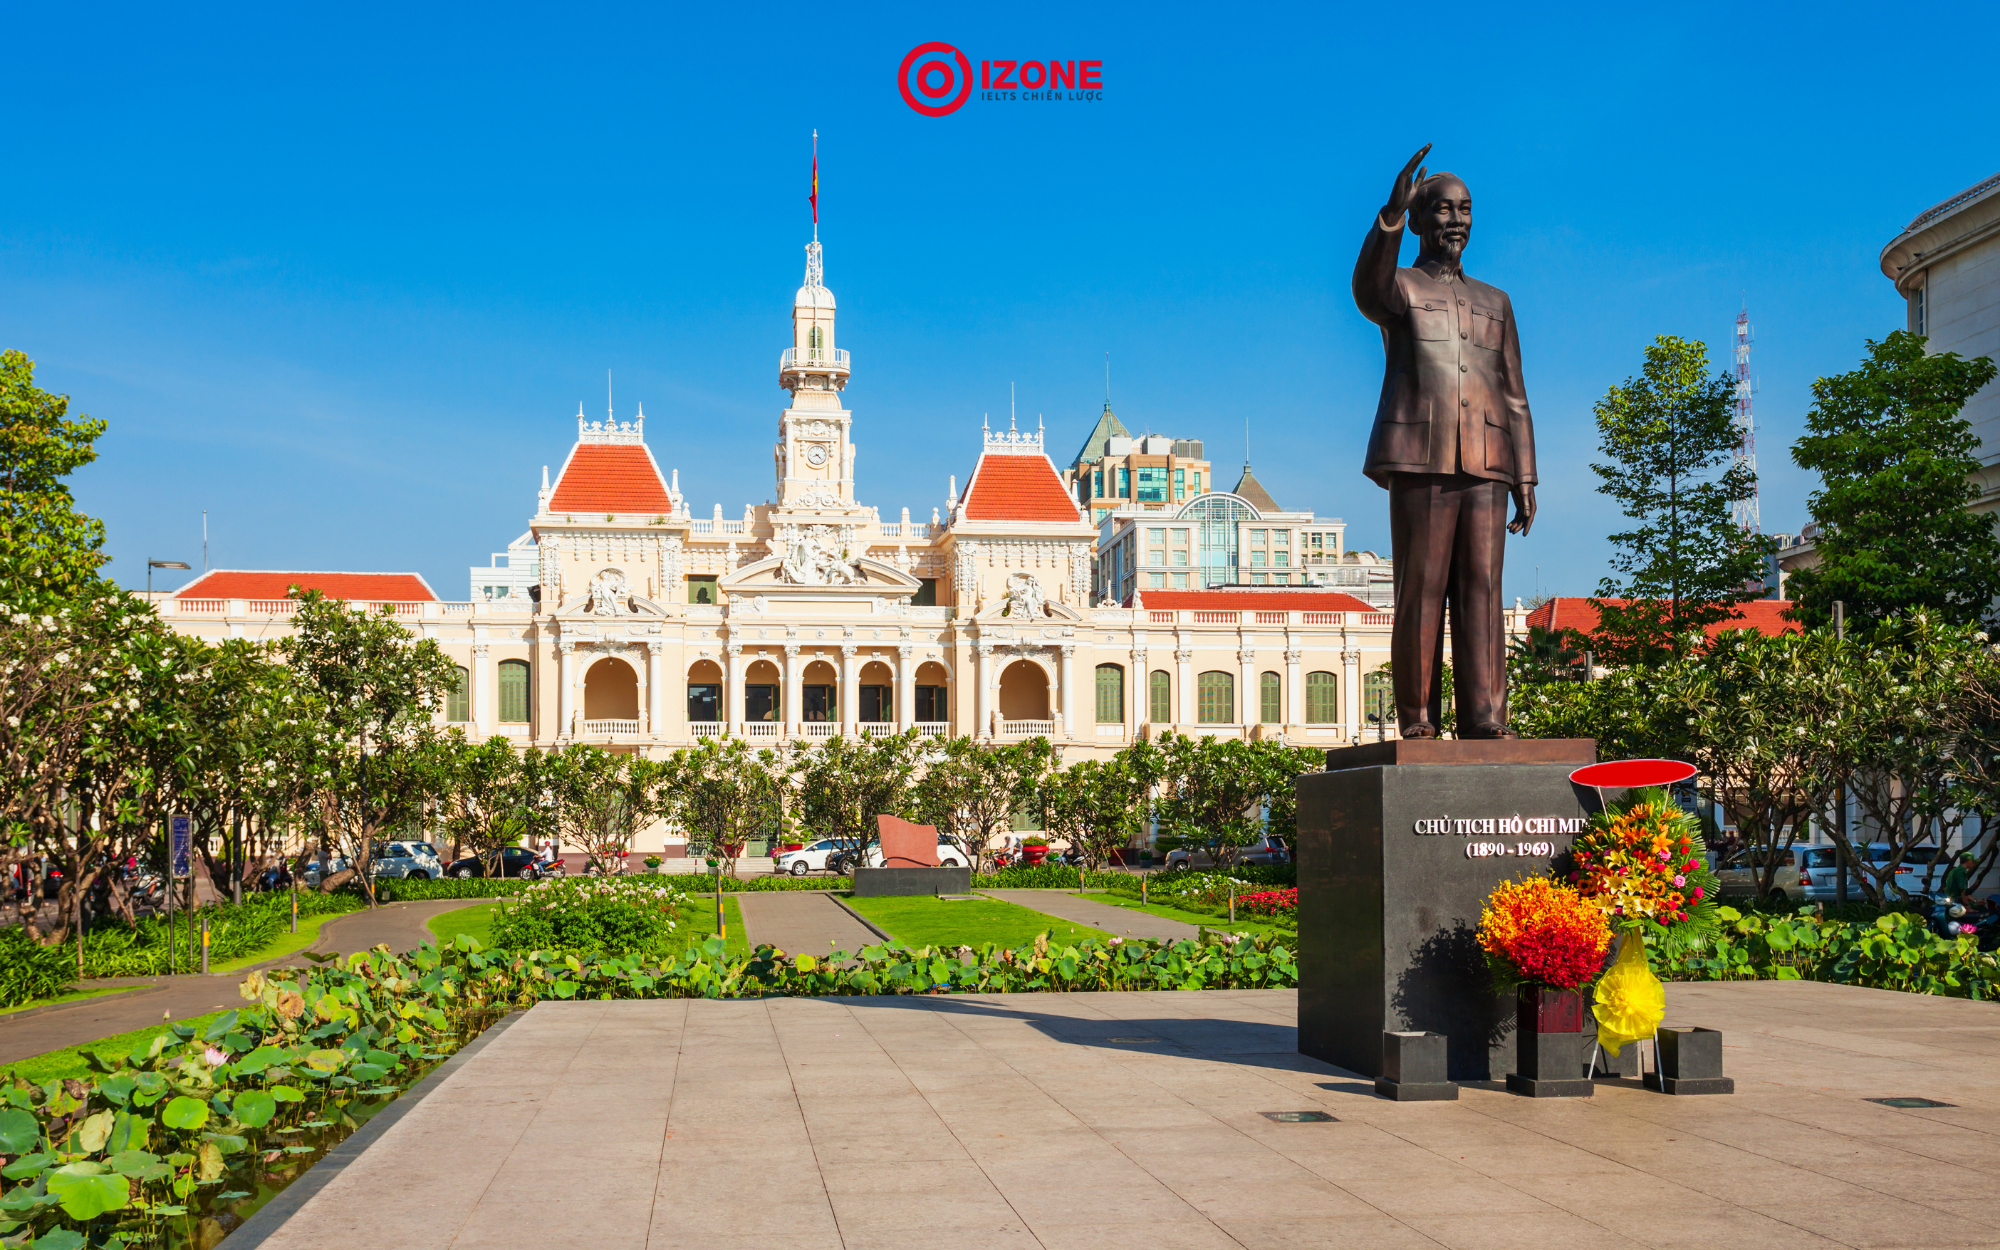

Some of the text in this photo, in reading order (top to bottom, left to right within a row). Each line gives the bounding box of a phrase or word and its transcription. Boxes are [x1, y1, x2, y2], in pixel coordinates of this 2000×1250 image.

[1414, 815, 1451, 834] CHỦ
[1454, 818, 1495, 837] TỊCH
[1498, 813, 1523, 834] HỒ
[1466, 842, 1505, 859] (1890
[1517, 841, 1556, 859] 1969)
